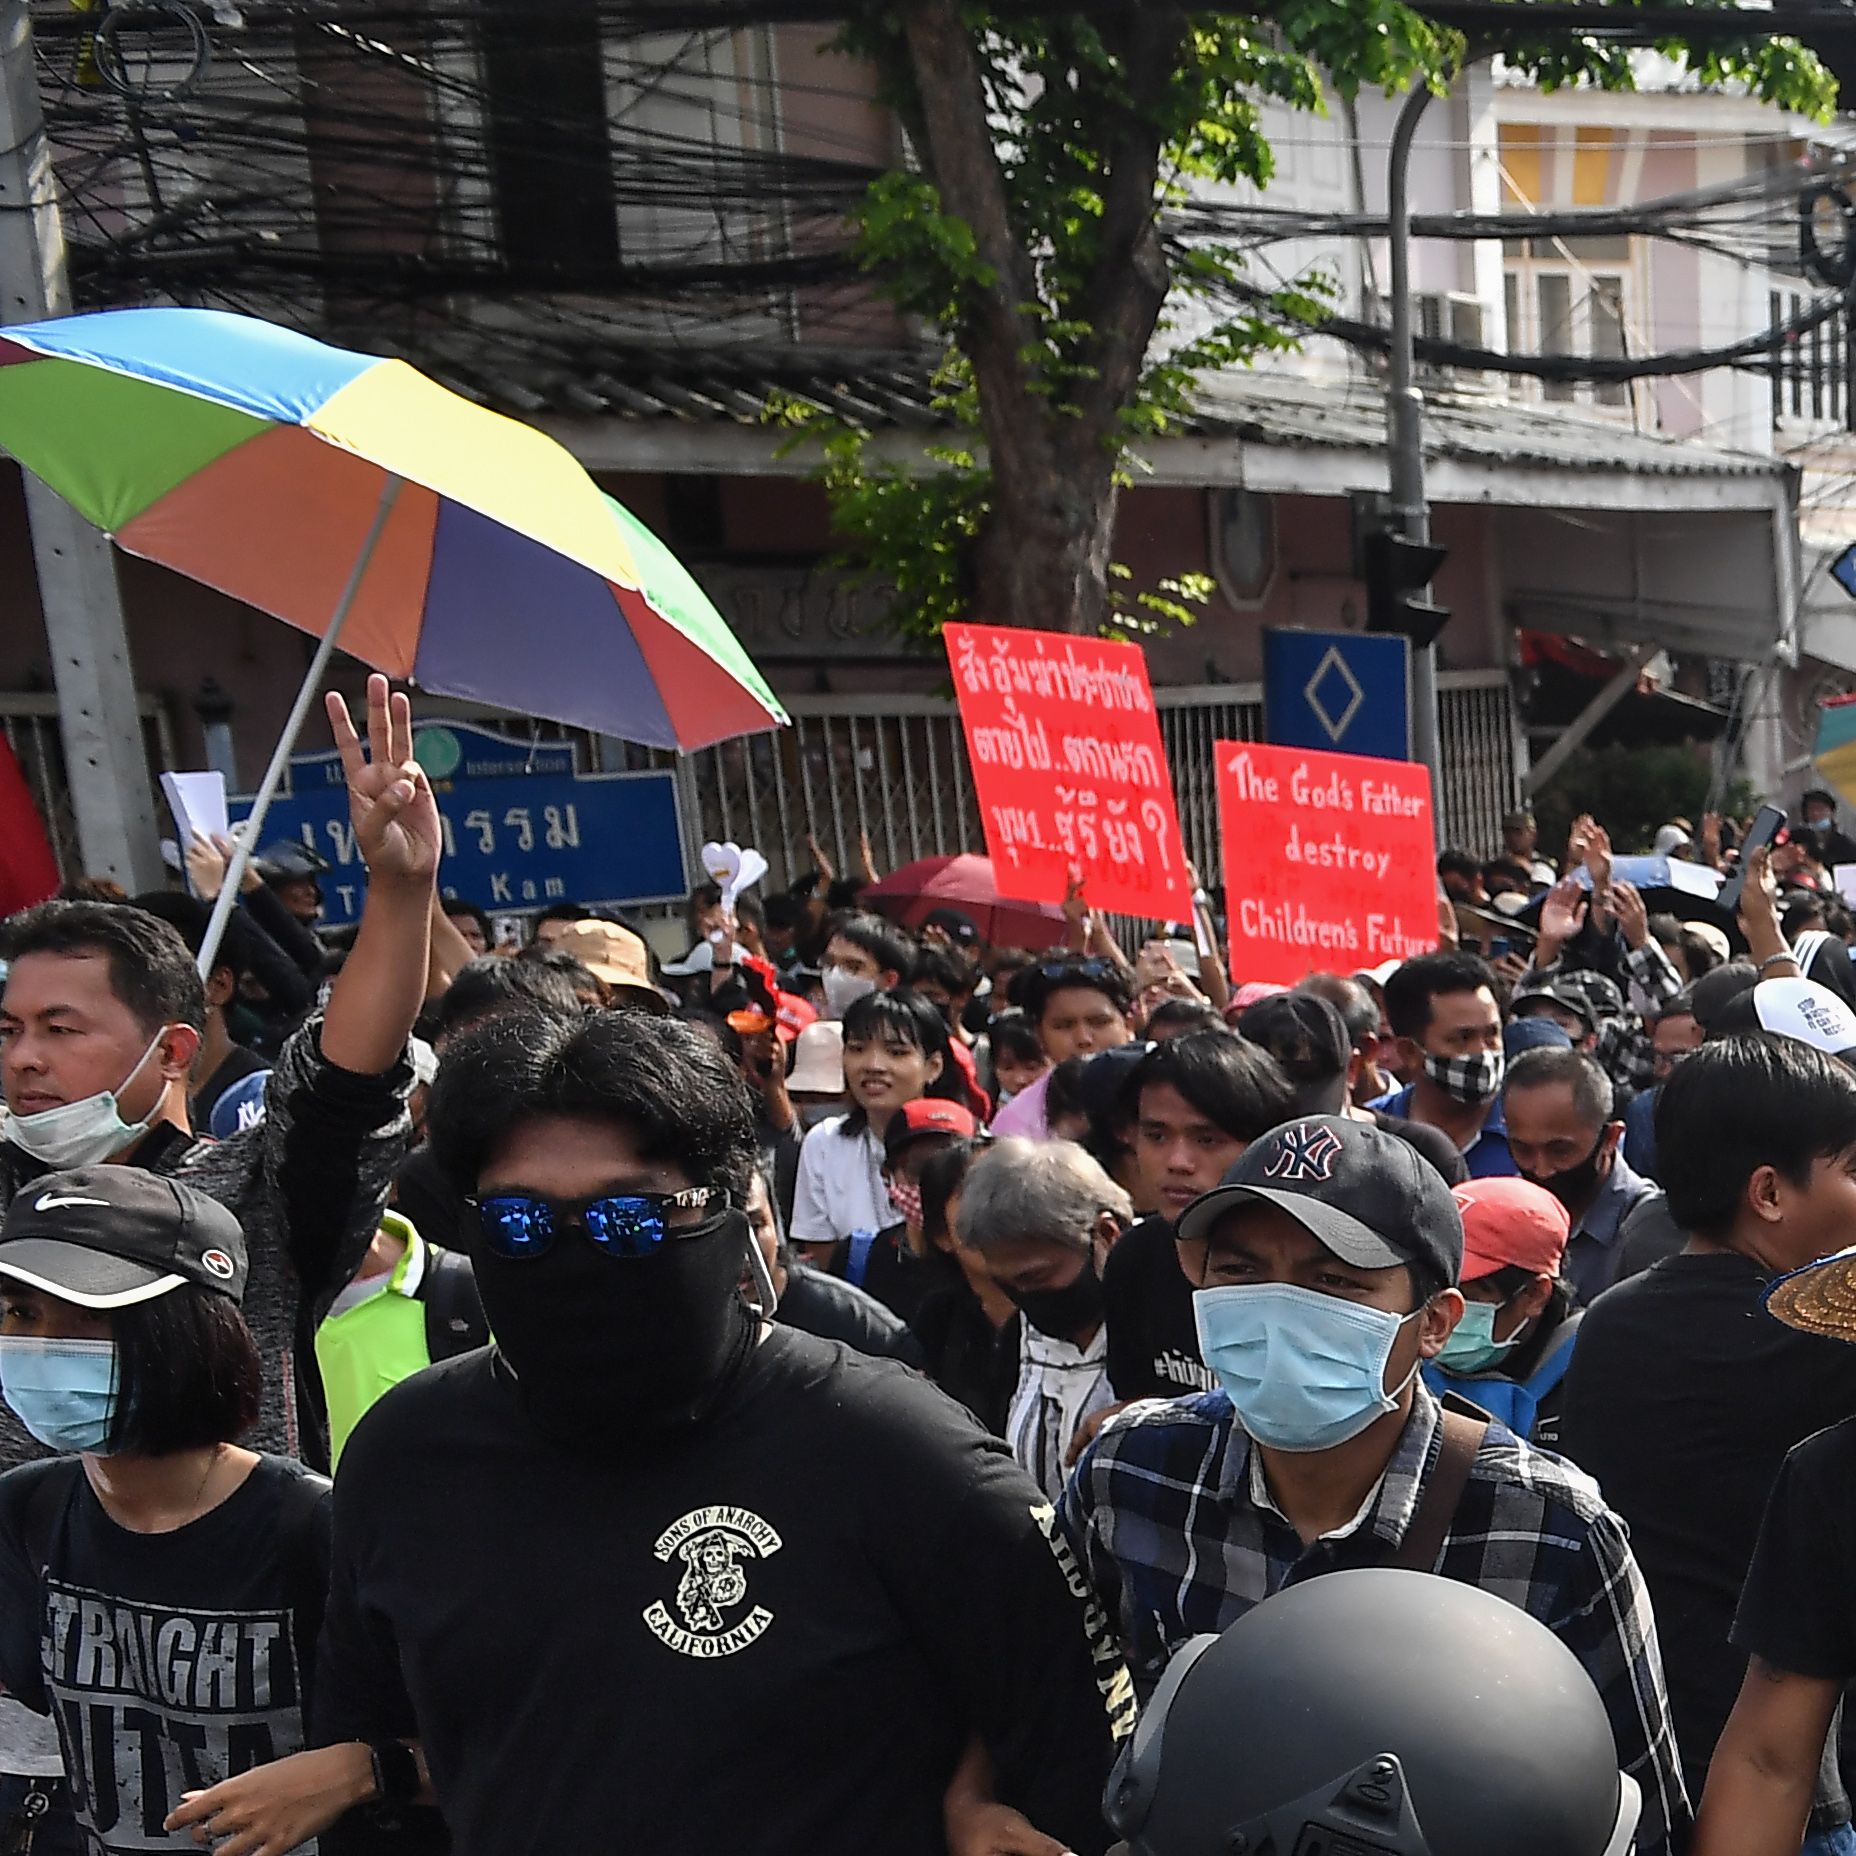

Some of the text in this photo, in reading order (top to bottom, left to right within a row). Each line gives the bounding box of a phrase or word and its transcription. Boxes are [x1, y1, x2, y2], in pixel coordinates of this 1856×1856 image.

[1228, 751, 1430, 820] The God's Father
[1286, 825, 1393, 882] destroy
[490, 872, 566, 903] Kam
[1240, 900, 1361, 955] Children's
[658, 1507, 780, 1556] SONS OF ANARCHY
[650, 1605, 771, 1656] CALIFORNIA
